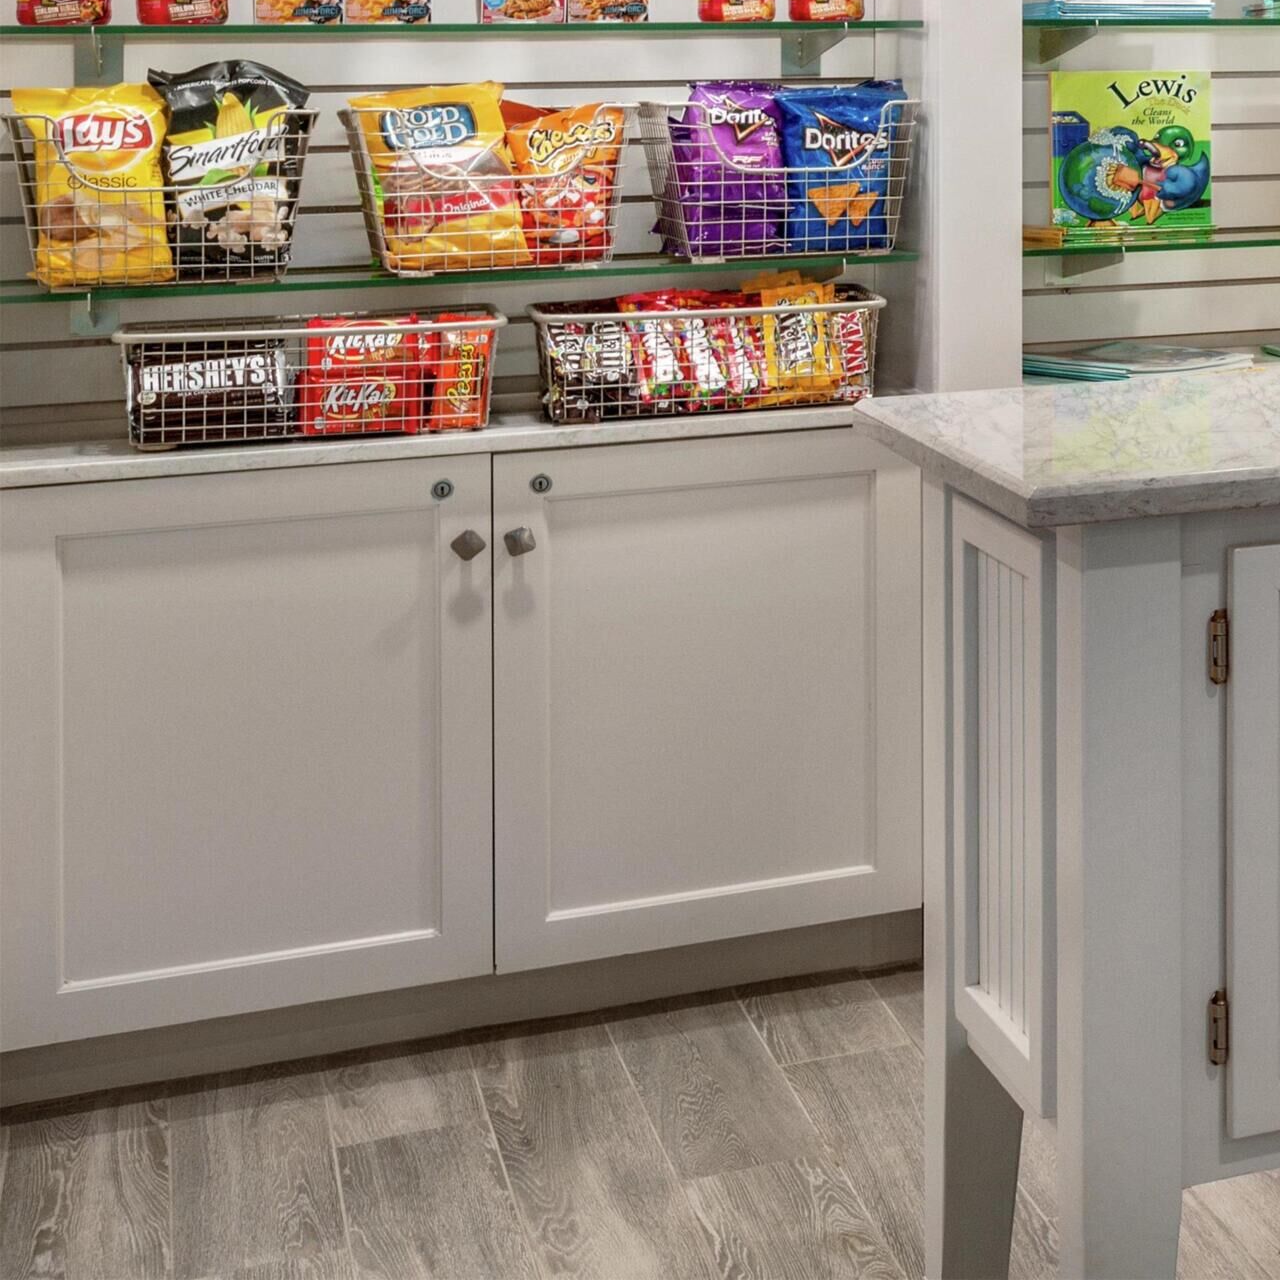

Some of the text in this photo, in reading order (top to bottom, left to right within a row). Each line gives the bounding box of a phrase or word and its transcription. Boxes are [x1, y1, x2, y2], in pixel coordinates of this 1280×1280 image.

[1107, 74, 1197, 109] Lewis
[396, 106, 463, 125] ROLD
[1131, 116, 1175, 125] the World
[1143, 107, 1172, 116] Cleans
[62, 114, 145, 153] Lay's
[805, 128, 889, 150] Doritos
[168, 124, 288, 177] Smartfood
[67, 173, 137, 189] Classic
[183, 181, 278, 208] WHITE CHEDDAR
[143, 355, 265, 392] HERSHEY'S
[448, 344, 474, 411] Reese's
[325, 384, 391, 412] KitKat
